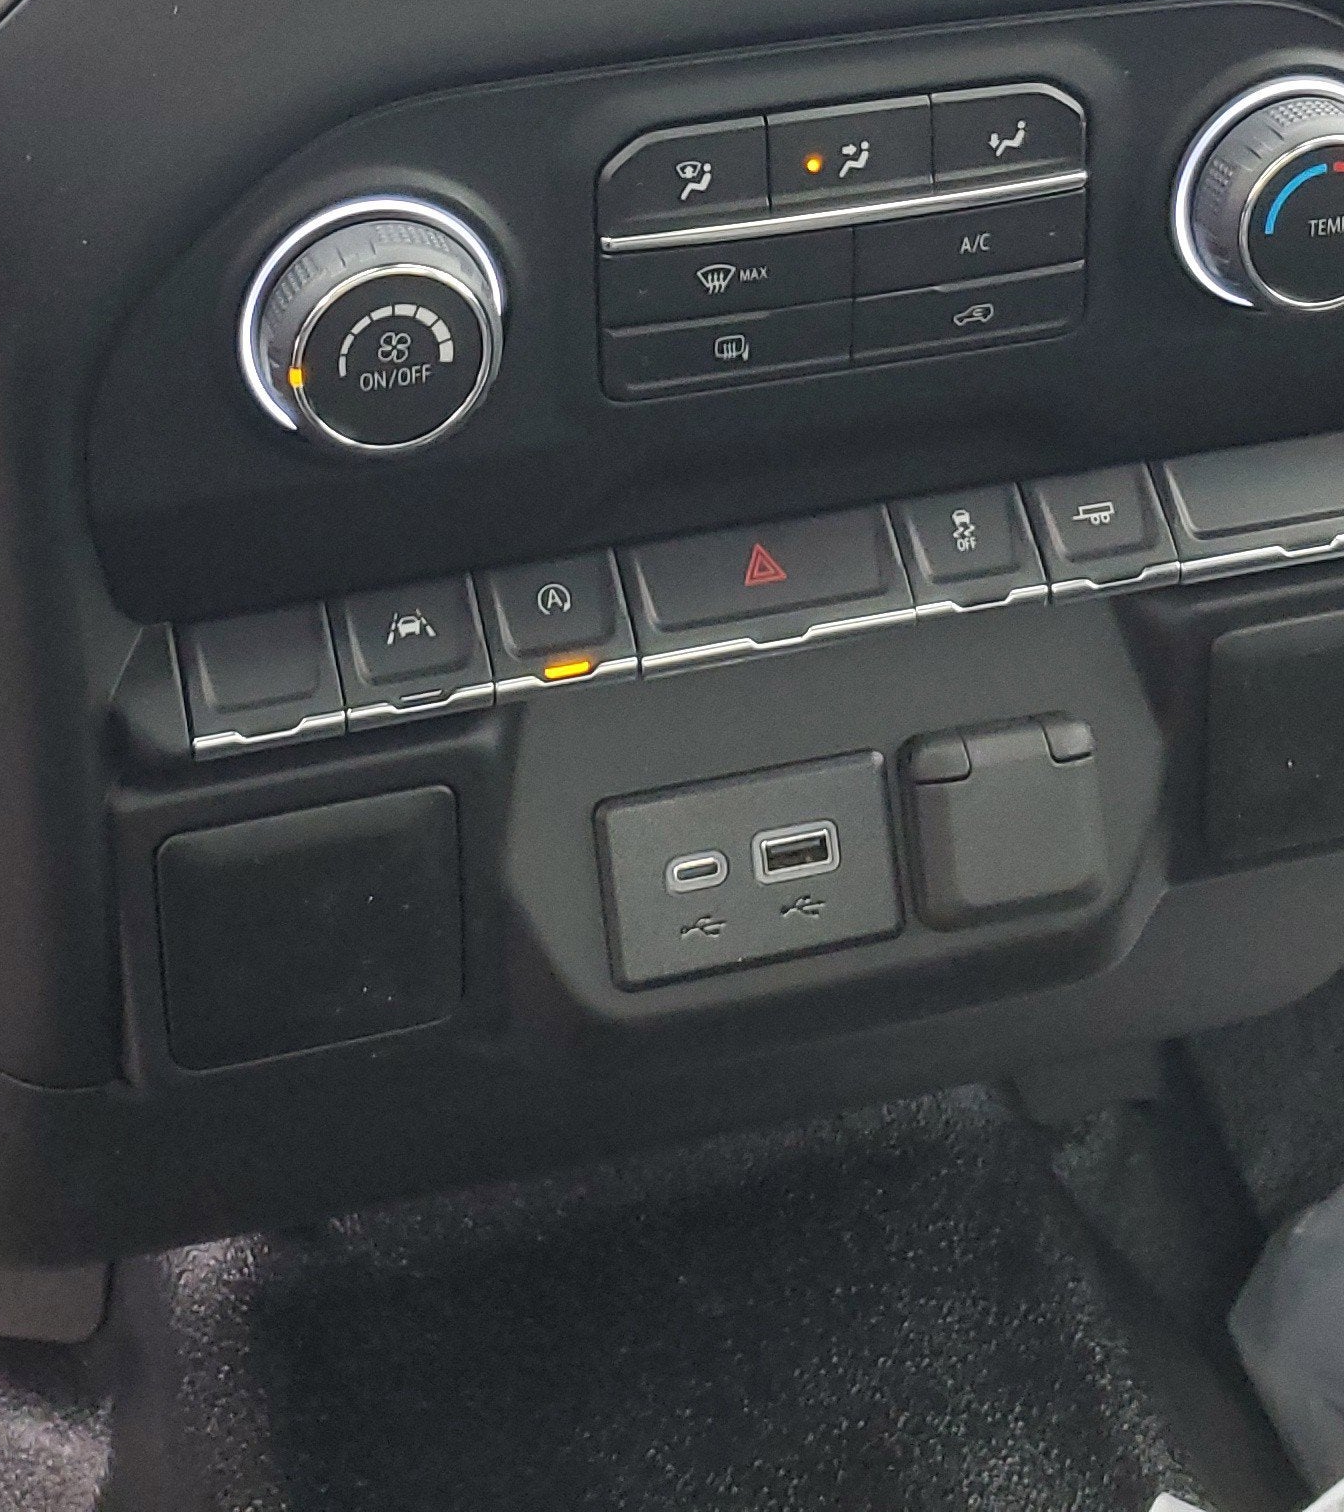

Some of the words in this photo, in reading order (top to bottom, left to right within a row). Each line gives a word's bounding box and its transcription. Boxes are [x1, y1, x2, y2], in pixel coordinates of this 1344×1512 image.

[959, 233, 992, 254] A/C
[739, 265, 768, 282] MAX
[359, 363, 434, 393] ON/OFF
[956, 536, 977, 552] OFF
